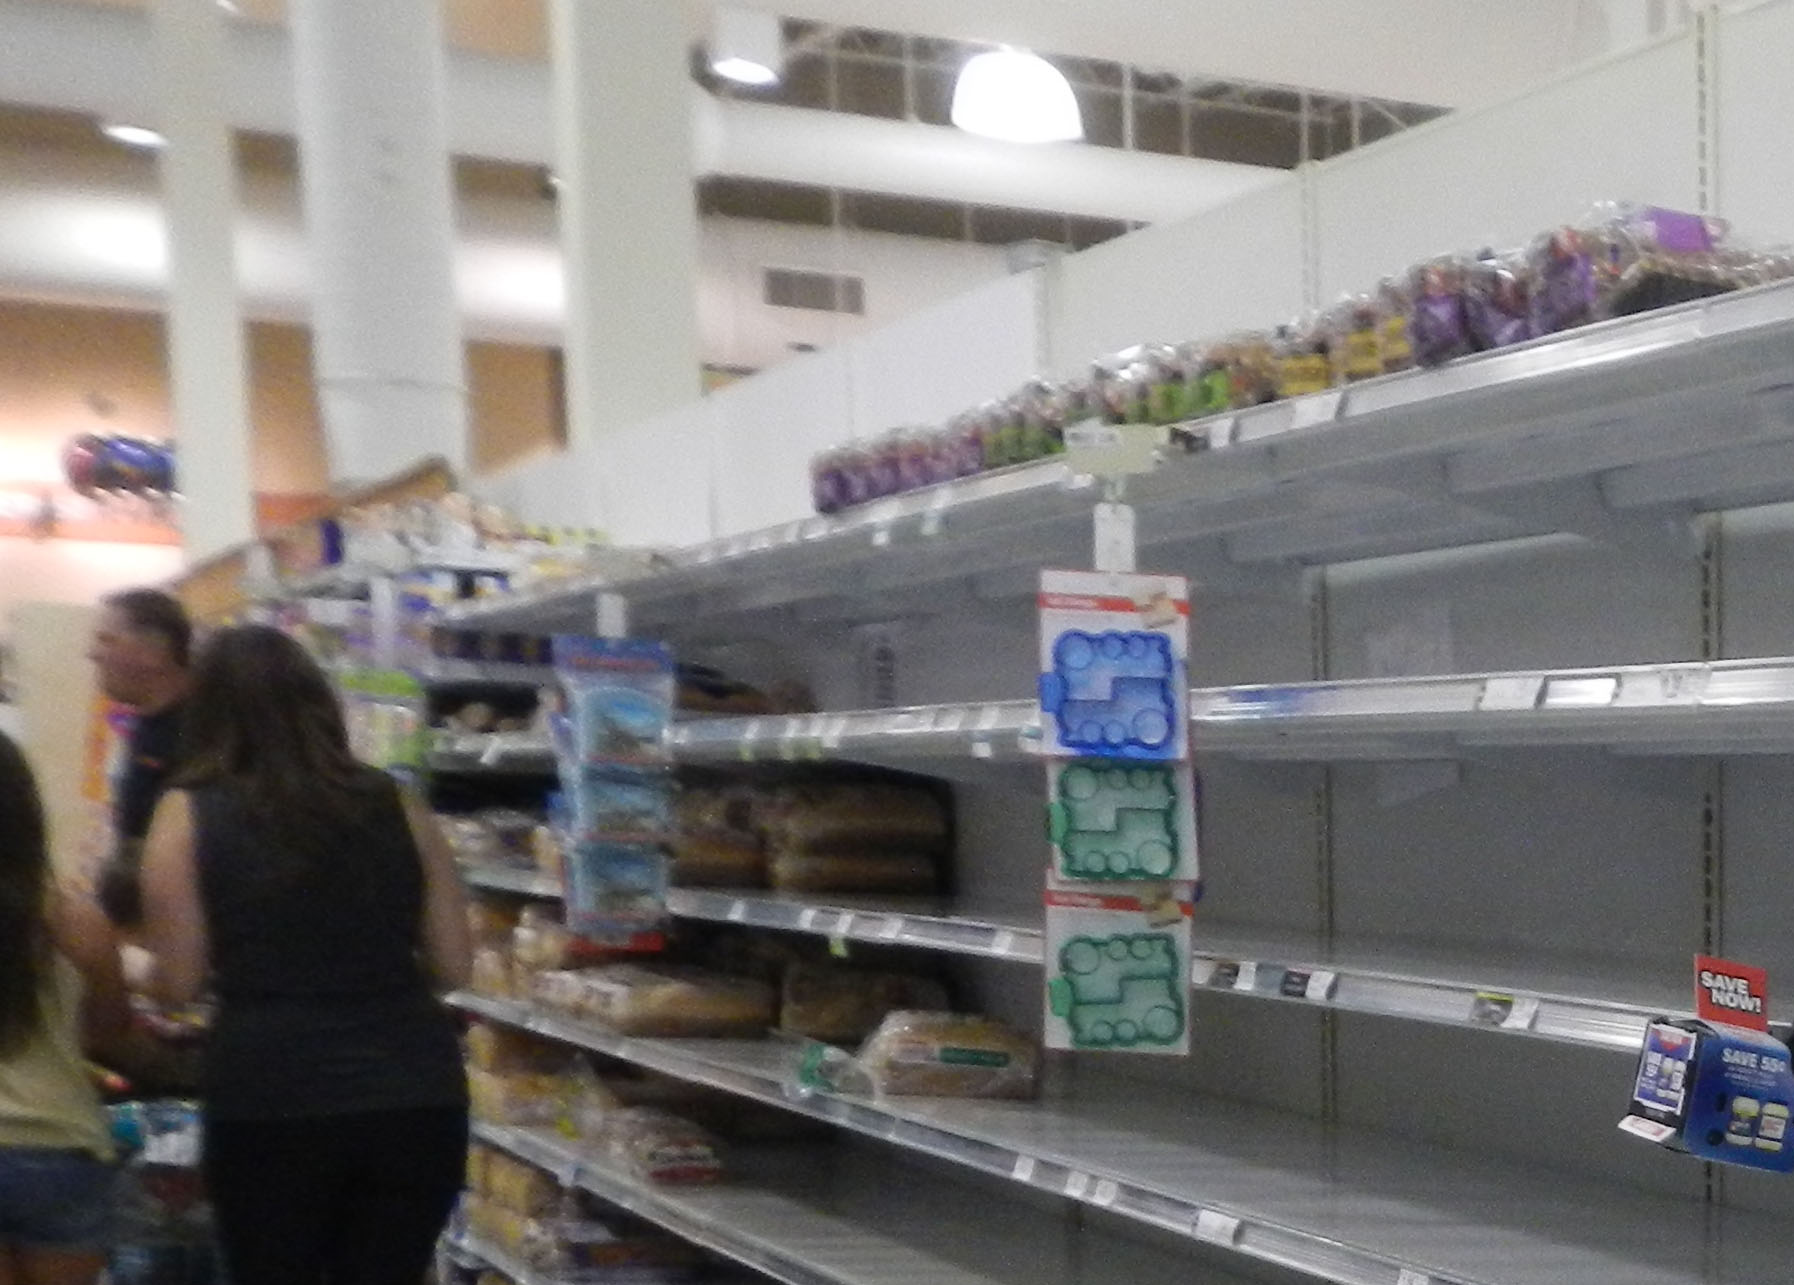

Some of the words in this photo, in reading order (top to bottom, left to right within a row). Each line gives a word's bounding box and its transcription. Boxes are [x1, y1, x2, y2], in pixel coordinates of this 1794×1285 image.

[1700, 970, 1749, 995] SAVE
[1711, 988, 1762, 1014] NOW!
[1721, 1047, 1758, 1069] SAVE
